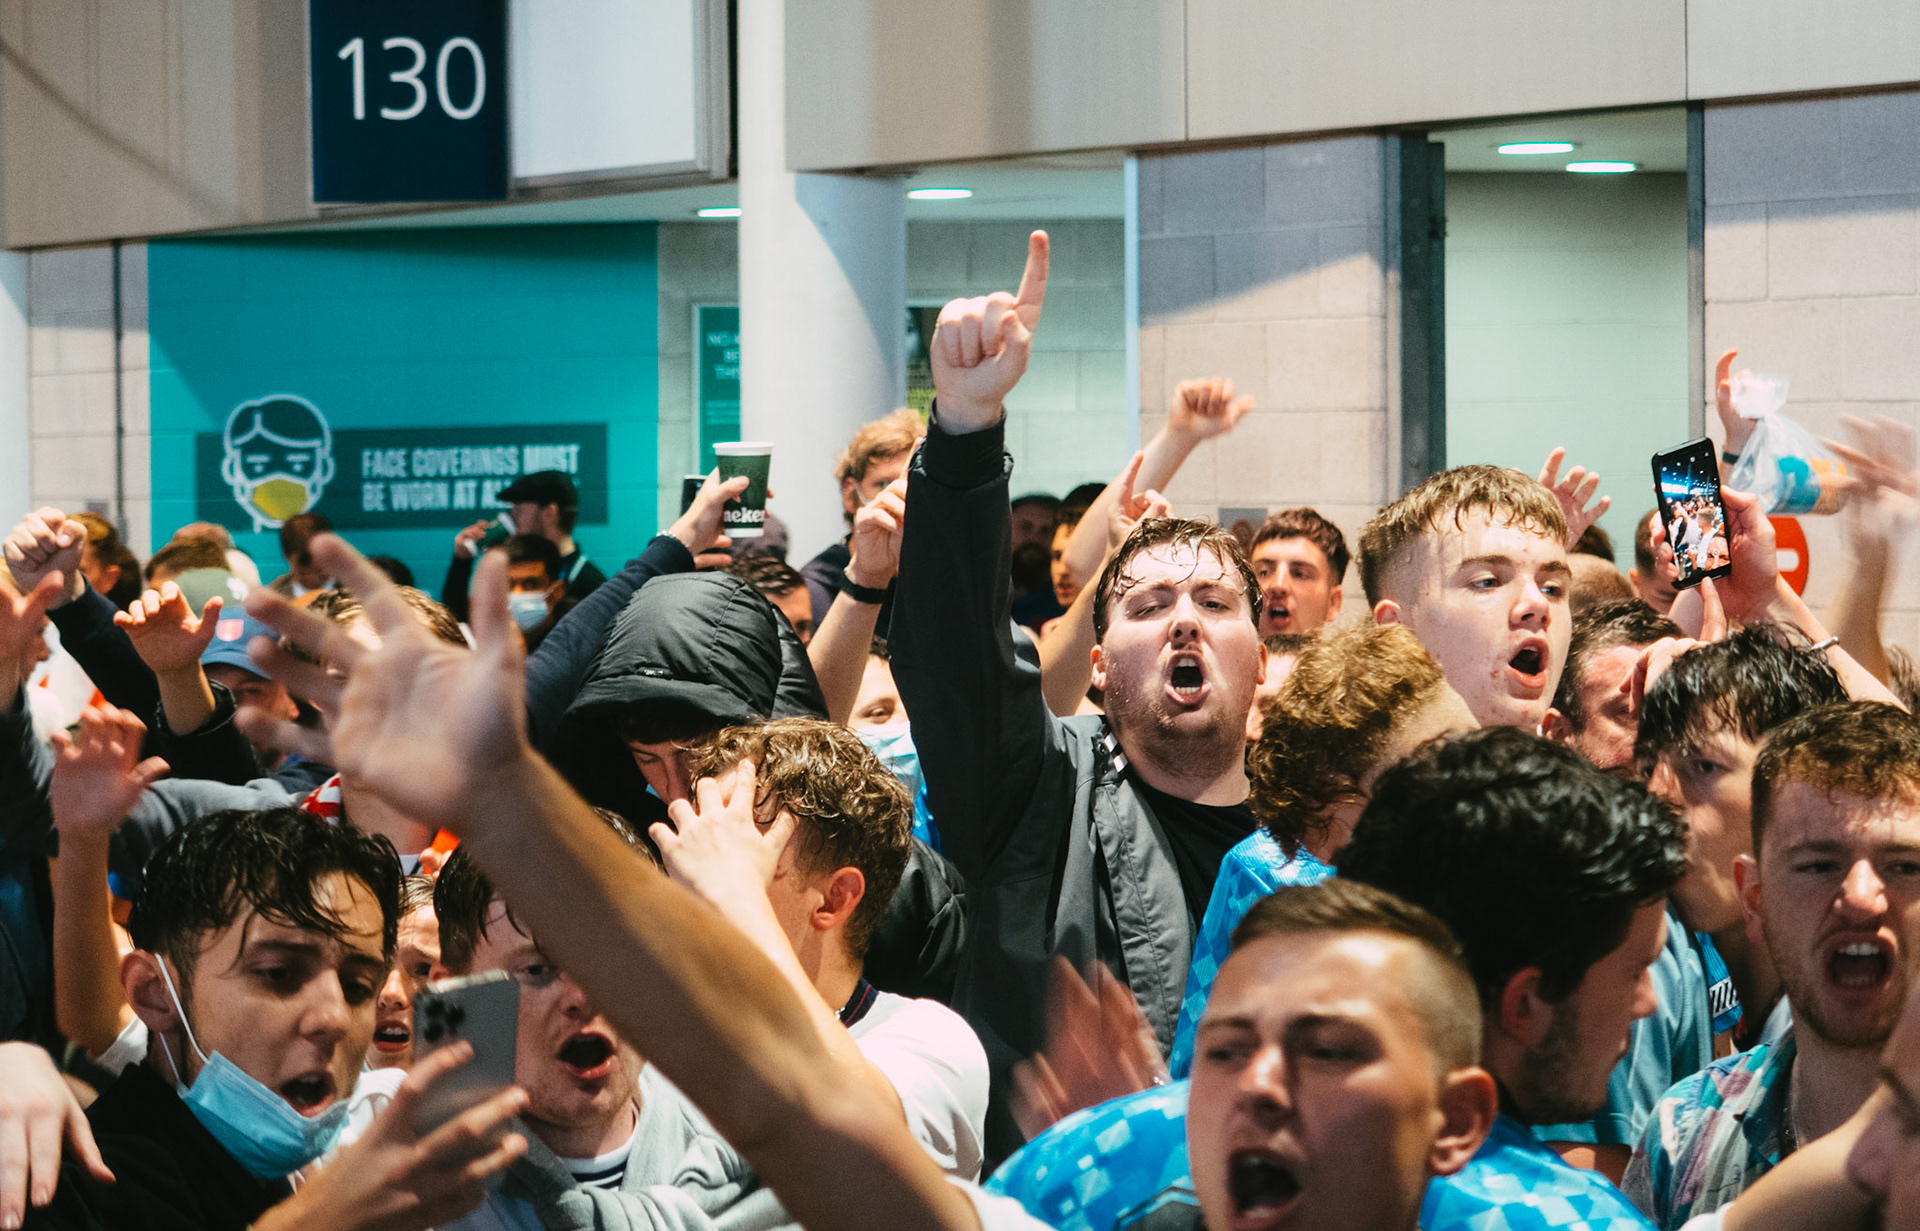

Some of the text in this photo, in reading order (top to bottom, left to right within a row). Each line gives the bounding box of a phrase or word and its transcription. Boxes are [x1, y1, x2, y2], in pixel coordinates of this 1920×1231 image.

[337, 36, 486, 121] 130
[361, 444, 580, 478] FACE COVERINGS MUST
[362, 481, 386, 512] BE
[389, 480, 449, 511] WORN
[453, 479, 477, 510] AT
